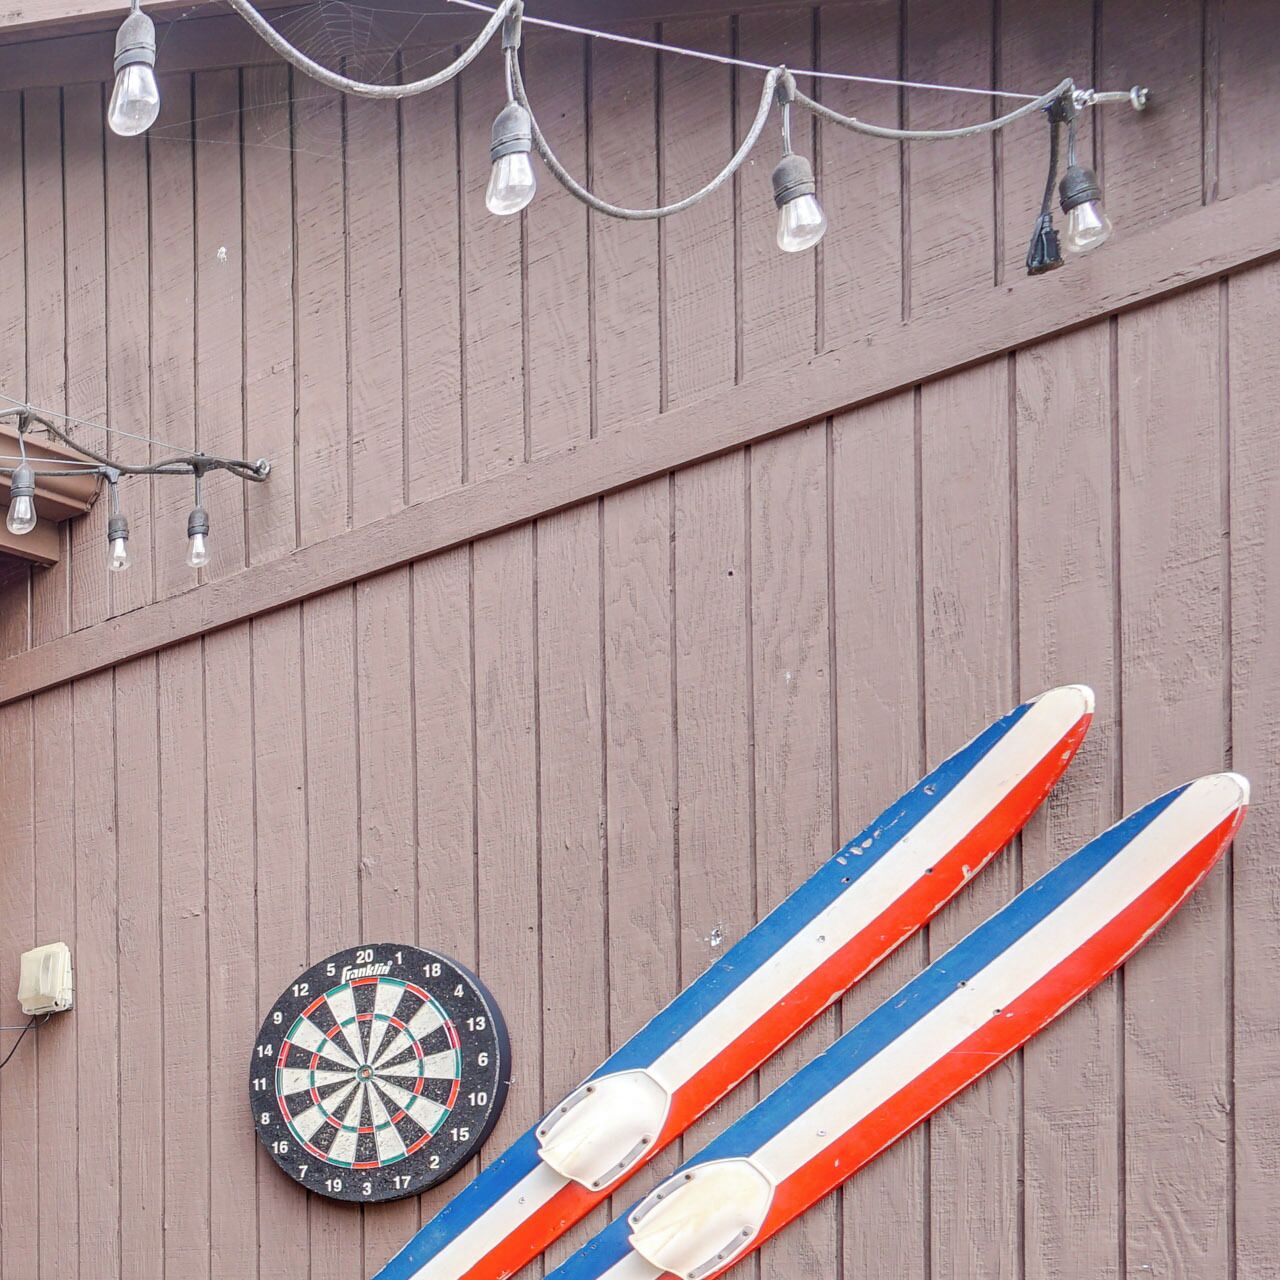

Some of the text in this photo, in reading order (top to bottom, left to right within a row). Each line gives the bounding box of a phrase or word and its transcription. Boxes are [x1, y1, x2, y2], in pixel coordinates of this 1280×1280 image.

[355, 948, 374, 964] 20
[394, 951, 403, 965] 1
[326, 962, 336, 977] 5
[341, 963, 390, 984] Franklin
[422, 962, 442, 978] 18
[291, 982, 310, 998] 12
[453, 983, 465, 998] 4
[273, 1011, 283, 1025] 9
[466, 1016, 486, 1032] 13
[256, 1043, 274, 1058] 14
[477, 1051, 489, 1067] 6
[252, 1077, 267, 1091] 11
[467, 1091, 488, 1107] 10
[260, 1112, 271, 1125] 8
[450, 1126, 470, 1142] 15
[271, 1140, 289, 1154] 16
[429, 1155, 440, 1169] 2
[298, 1164, 309, 1178] 7
[324, 1177, 343, 1193] 19
[362, 1181, 372, 1196] 3
[392, 1175, 412, 1190] 17
